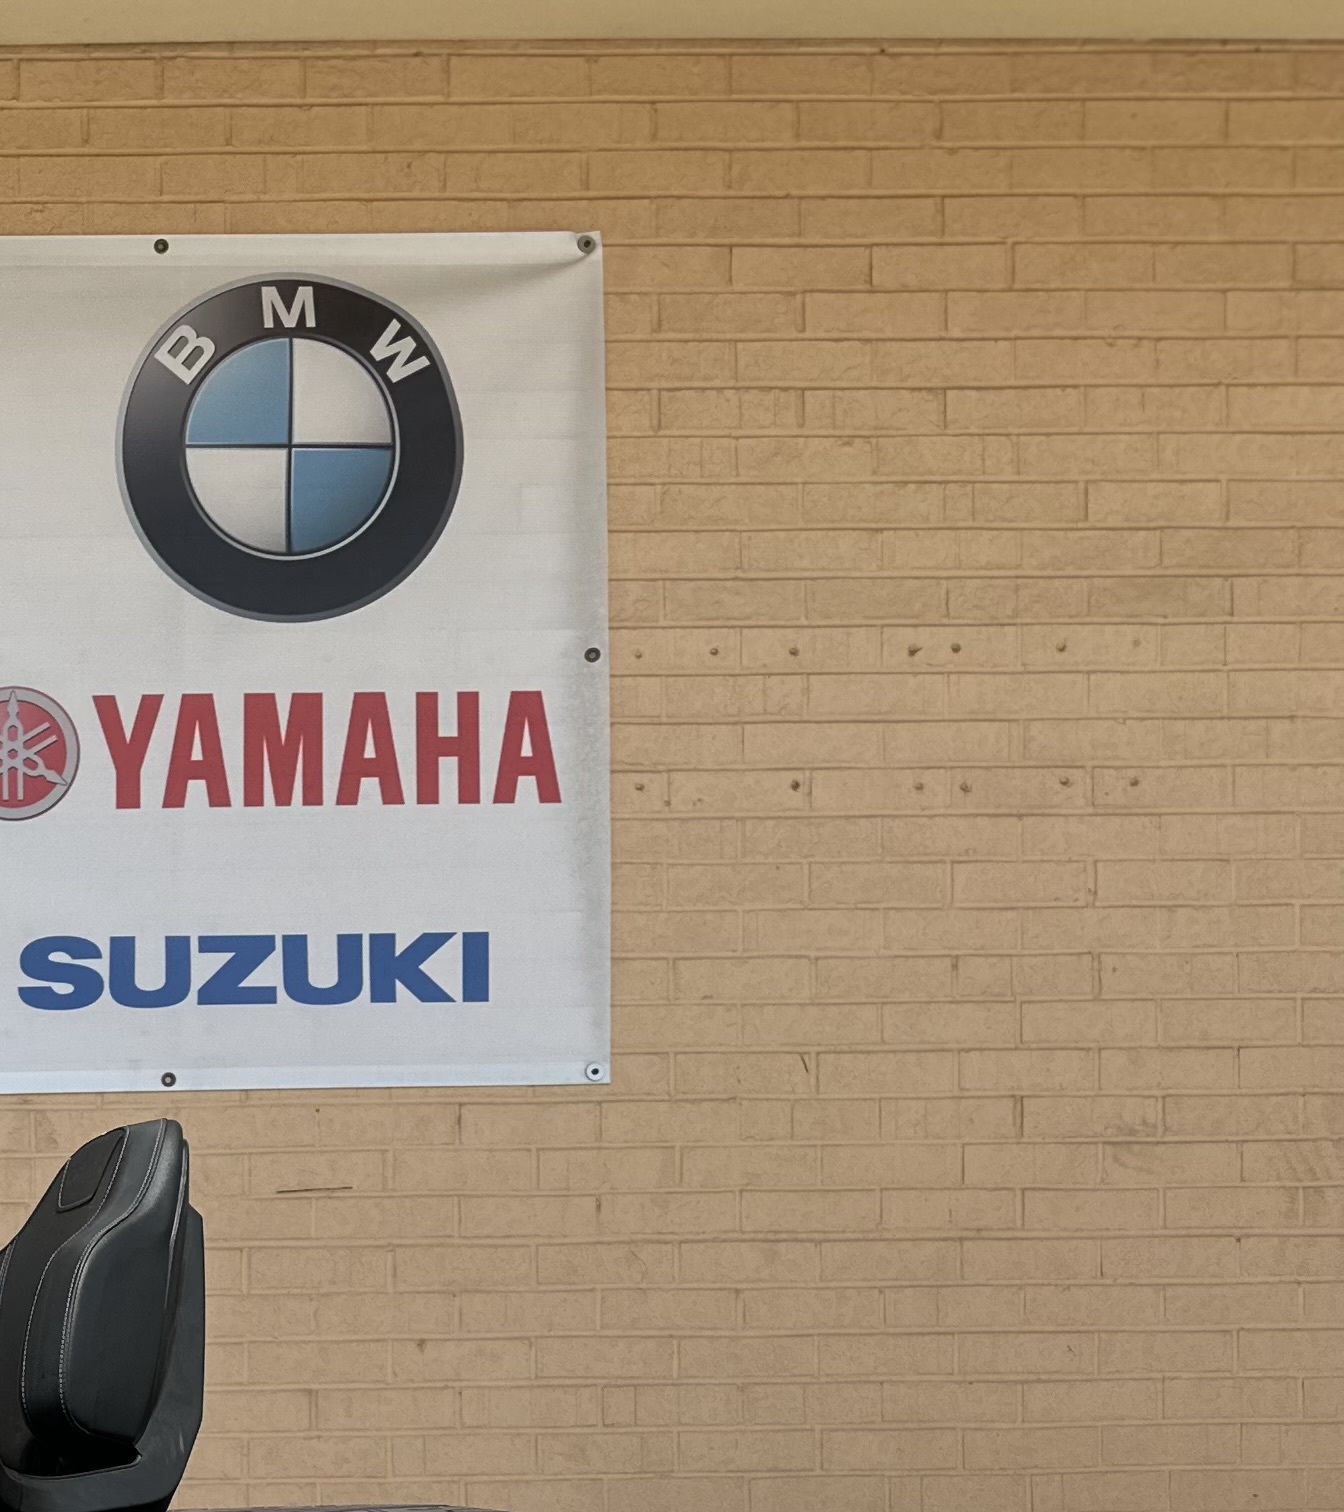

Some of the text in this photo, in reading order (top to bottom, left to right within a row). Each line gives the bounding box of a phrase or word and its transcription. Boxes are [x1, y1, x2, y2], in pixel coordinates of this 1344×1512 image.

[154, 285, 431, 386] BMW
[91, 690, 563, 810] YAMAHA
[16, 931, 491, 1011] SUZUKI
